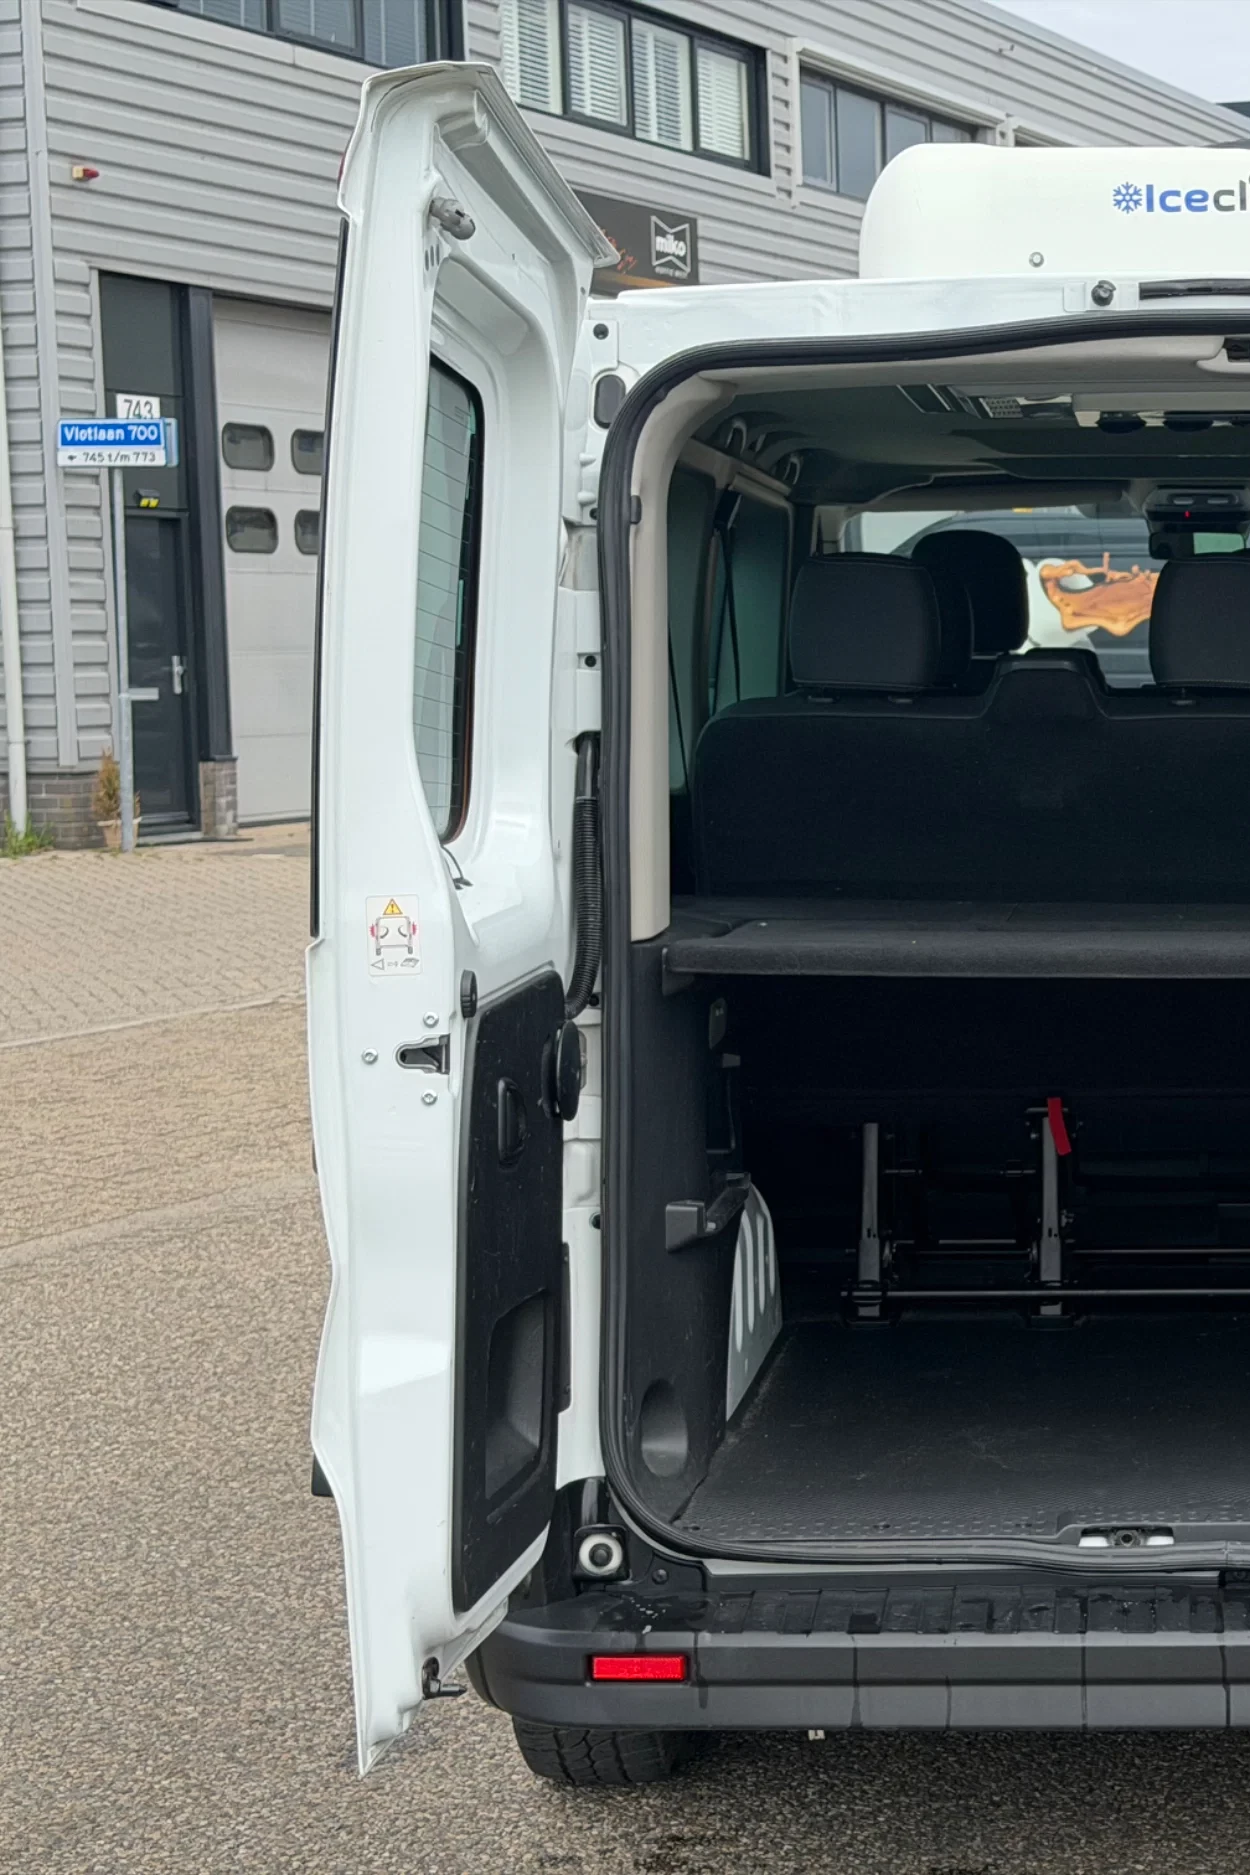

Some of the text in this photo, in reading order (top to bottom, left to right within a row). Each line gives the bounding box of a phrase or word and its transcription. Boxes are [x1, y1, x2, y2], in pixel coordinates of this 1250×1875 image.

[123, 399, 154, 419] 743
[63, 424, 158, 442] Vlotlaan 700
[82, 451, 156, 463] 745 t/m 773
